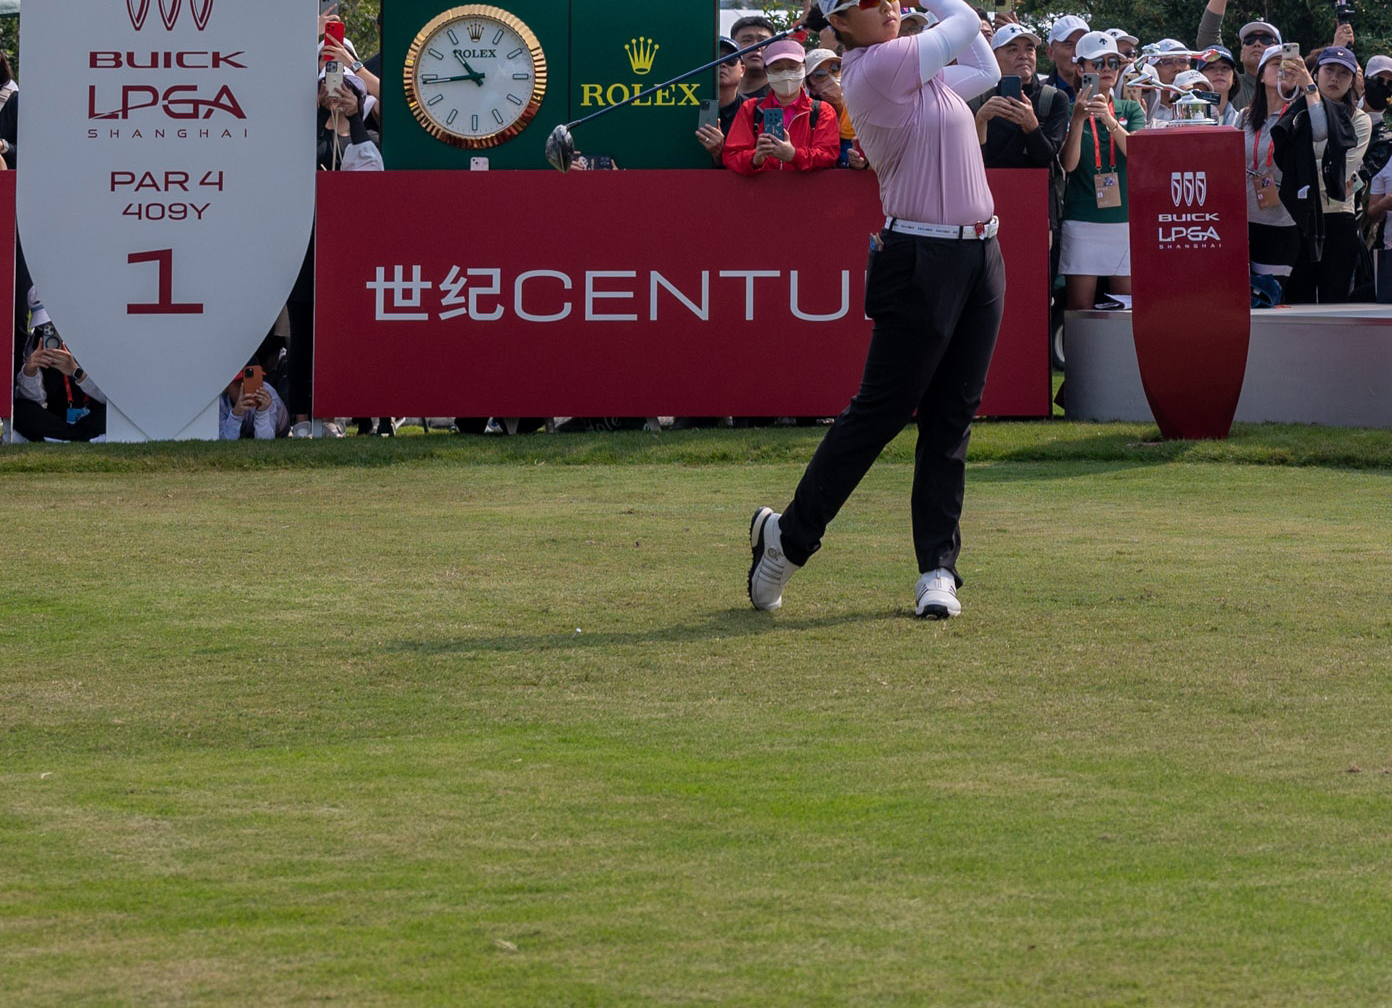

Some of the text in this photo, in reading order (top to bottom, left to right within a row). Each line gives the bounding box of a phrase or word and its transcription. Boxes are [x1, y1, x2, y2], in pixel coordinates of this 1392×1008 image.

[88, 50, 249, 69] BUICK
[88, 84, 248, 120] LPGA
[580, 83, 701, 106] ROLEX
[87, 128, 248, 139] SHANGHAI
[110, 170, 224, 192] PAR 4
[121, 202, 212, 221] 409Y
[1158, 212, 1221, 222] BUICK
[1158, 226, 1221, 242] LPGA
[126, 248, 204, 315] 1
